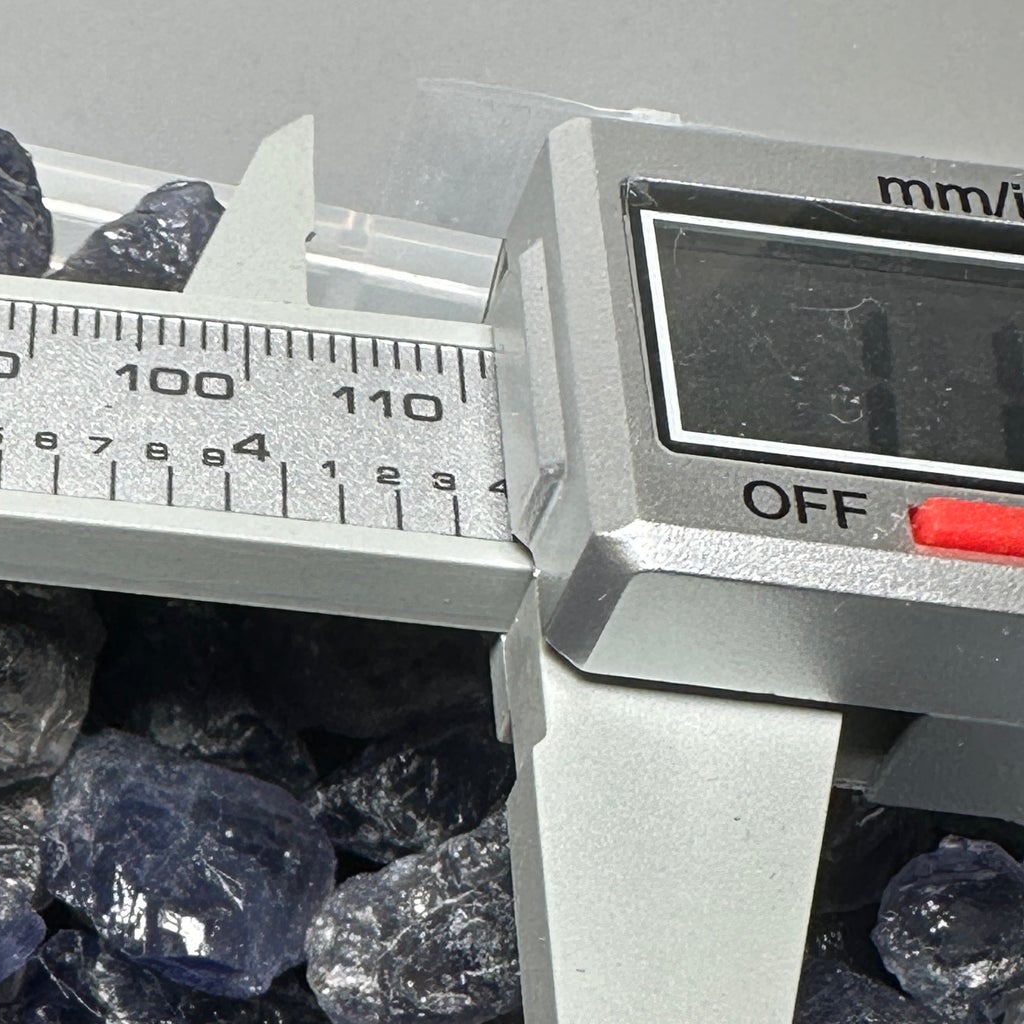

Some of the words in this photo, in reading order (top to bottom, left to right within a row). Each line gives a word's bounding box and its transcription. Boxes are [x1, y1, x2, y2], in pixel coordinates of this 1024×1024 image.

[115, 363, 235, 401] 100
[332, 385, 444, 424] 110
[33, 430, 59, 451] 6
[88, 435, 114, 456] 7
[144, 441, 170, 463] 8
[201, 447, 226, 468] 9
[231, 432, 271, 463] 4
[321, 460, 337, 479] 1
[376, 465, 401, 487] 2
[431, 471, 457, 492] 3
[742, 480, 868, 529] OFF
